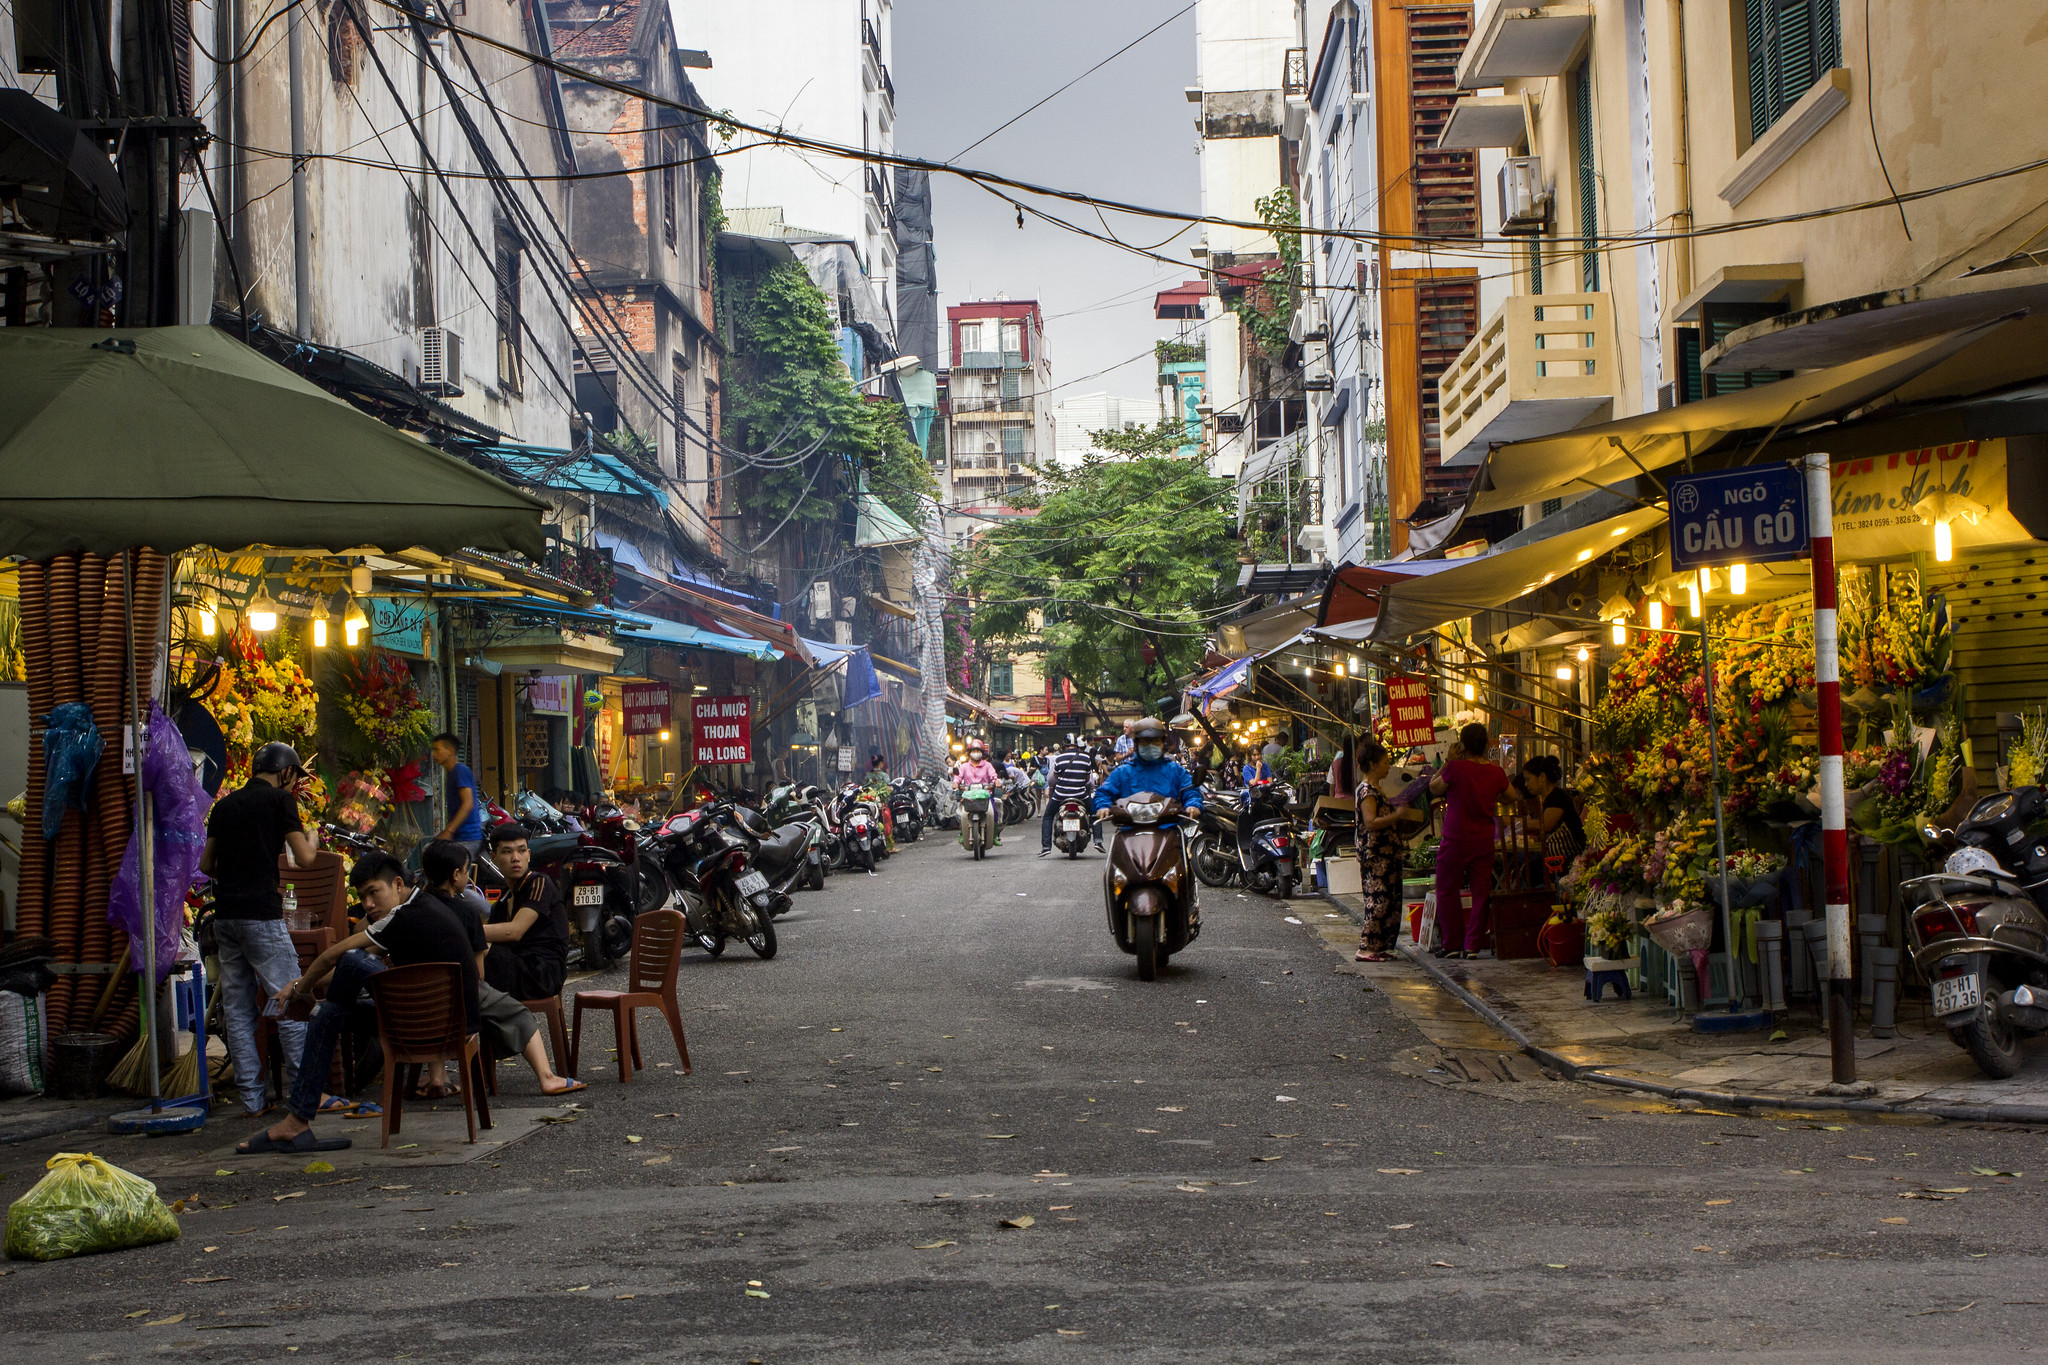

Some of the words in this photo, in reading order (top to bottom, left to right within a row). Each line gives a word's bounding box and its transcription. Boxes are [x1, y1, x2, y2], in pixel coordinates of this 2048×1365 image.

[1723, 481, 1767, 506] NGÕ
[1682, 506, 1743, 555] CẦU
[1753, 498, 1796, 546] GỖ
[1389, 679, 1407, 700] CHẢ
[1407, 682, 1427, 700] MỰC
[696, 698, 718, 718] CHẢ
[721, 702, 747, 720] MỰC
[1397, 705, 1425, 721] THOAN
[703, 725, 740, 739] THOAN
[1396, 730, 1409, 746] HẠ
[1409, 727, 1432, 743] LONG
[698, 747, 713, 763] HẠ
[716, 746, 746, 760] LONG
[739, 873, 760, 887] 29-B1
[741, 880, 767, 896] 265.71
[575, 895, 601, 904] 910.90
[578, 886, 599, 896] 29-B1
[1937, 976, 1972, 998] 29-H1
[1936, 991, 1977, 1013] 297.36
